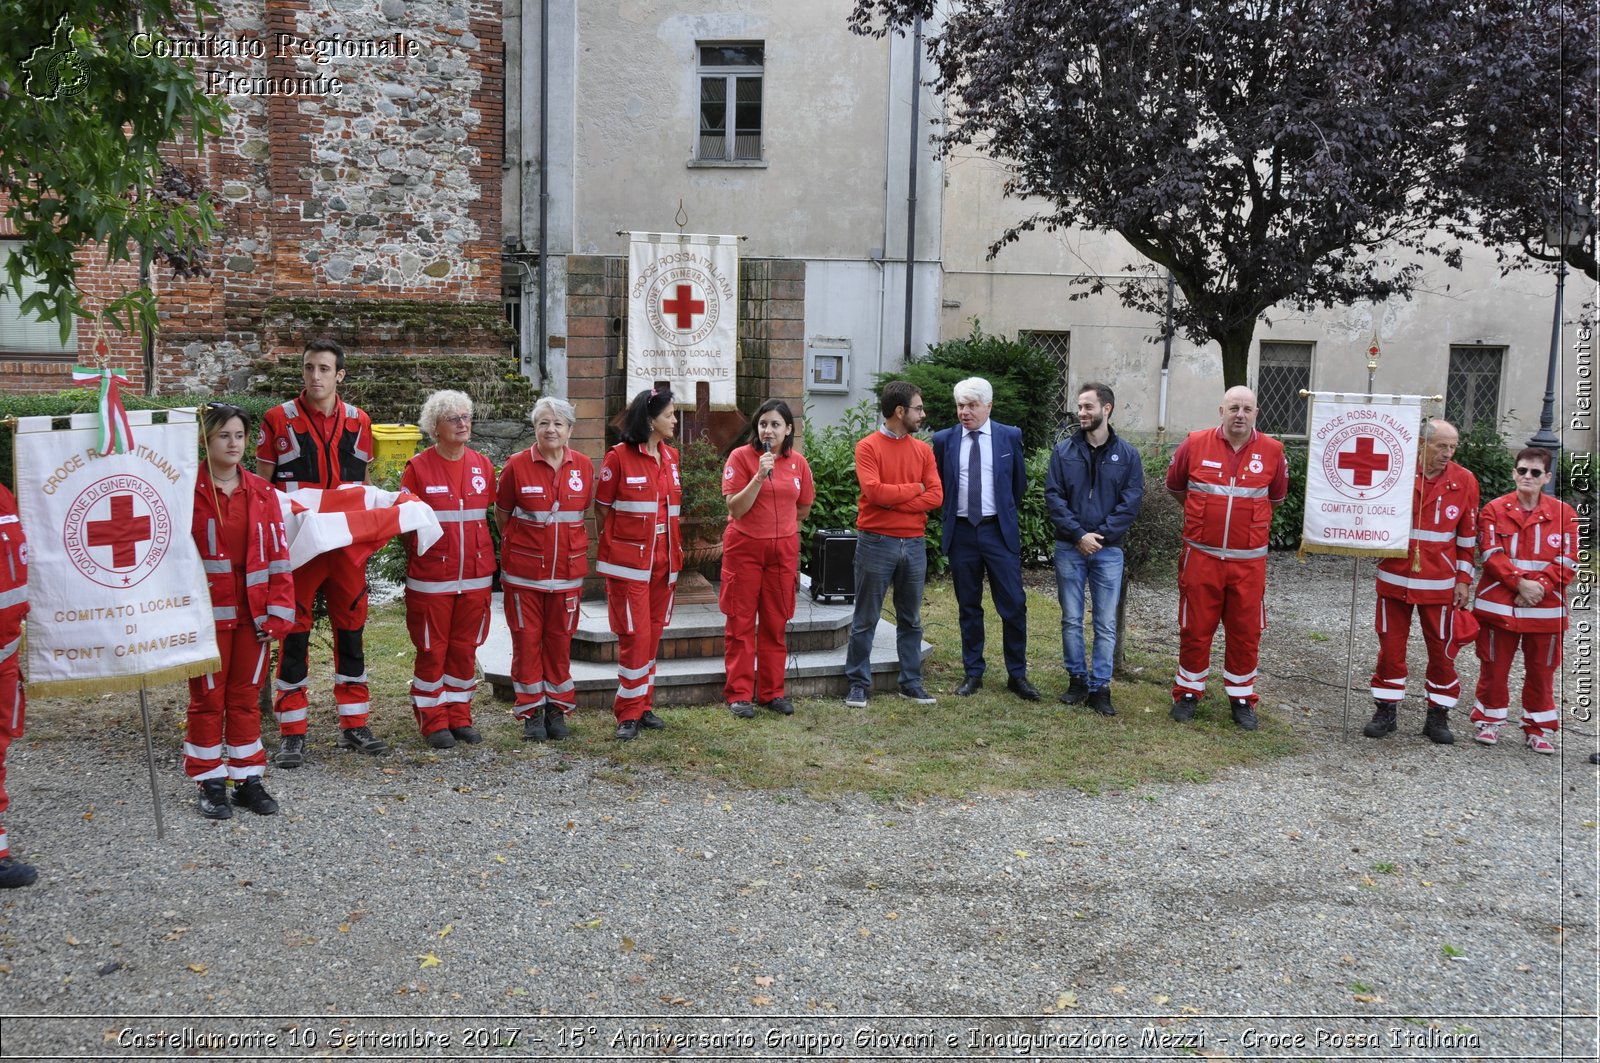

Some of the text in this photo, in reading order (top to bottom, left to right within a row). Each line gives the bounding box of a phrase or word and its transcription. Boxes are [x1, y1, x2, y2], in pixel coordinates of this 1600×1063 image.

[633, 252, 734, 301] CROCE ROSSA ITALIANA
[660, 275, 669, 286] DI
[705, 285, 714, 296] 22
[648, 286, 676, 341] CONVENZIONE
[642, 349, 721, 358] COMITATO LOCALE
[635, 367, 729, 377] CASTELLAMONTE
[1316, 409, 1413, 444] CROCE ROSSA ITALIANA
[1325, 425, 1402, 491] CONVENZIONE DI GINEVRA 22 AGOSTO 1864
[42, 445, 181, 497] CROCE ITALIANA
[1321, 502, 1396, 516] COMITATO LOCALE
[67, 478, 168, 575] CONVENZIONE DI GINEVRA 22 AGOSTO 1864
[1355, 516, 1363, 526] DI
[1323, 527, 1390, 542] STRAMBINO
[54, 595, 192, 623] COMITATO LOCALE
[126, 624, 138, 635] DI
[54, 631, 198, 661] PONT CANAVESE
